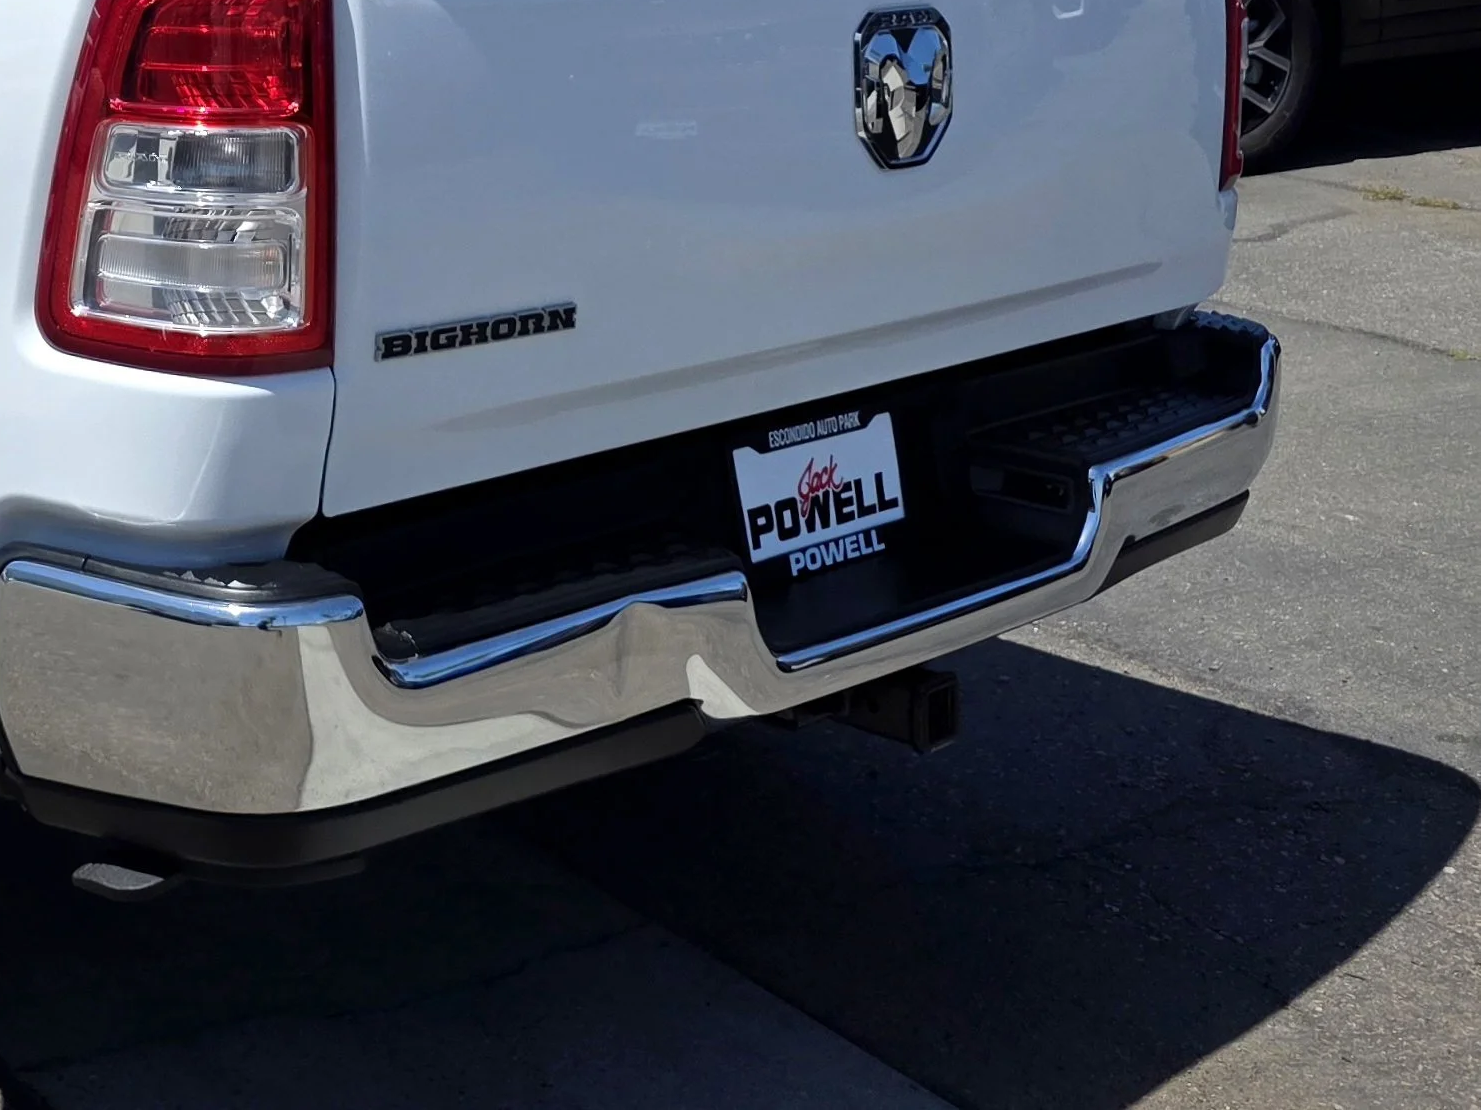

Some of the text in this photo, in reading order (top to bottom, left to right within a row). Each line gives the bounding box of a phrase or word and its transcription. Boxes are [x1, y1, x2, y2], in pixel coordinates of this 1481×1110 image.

[880, 10, 935, 27] RAM
[374, 302, 577, 362] BIGHORN
[769, 411, 861, 448] ESCONDIDO AUTO PARK
[748, 472, 898, 550] POWELL
[798, 455, 843, 518] Jack
[789, 529, 886, 577] POWELL
